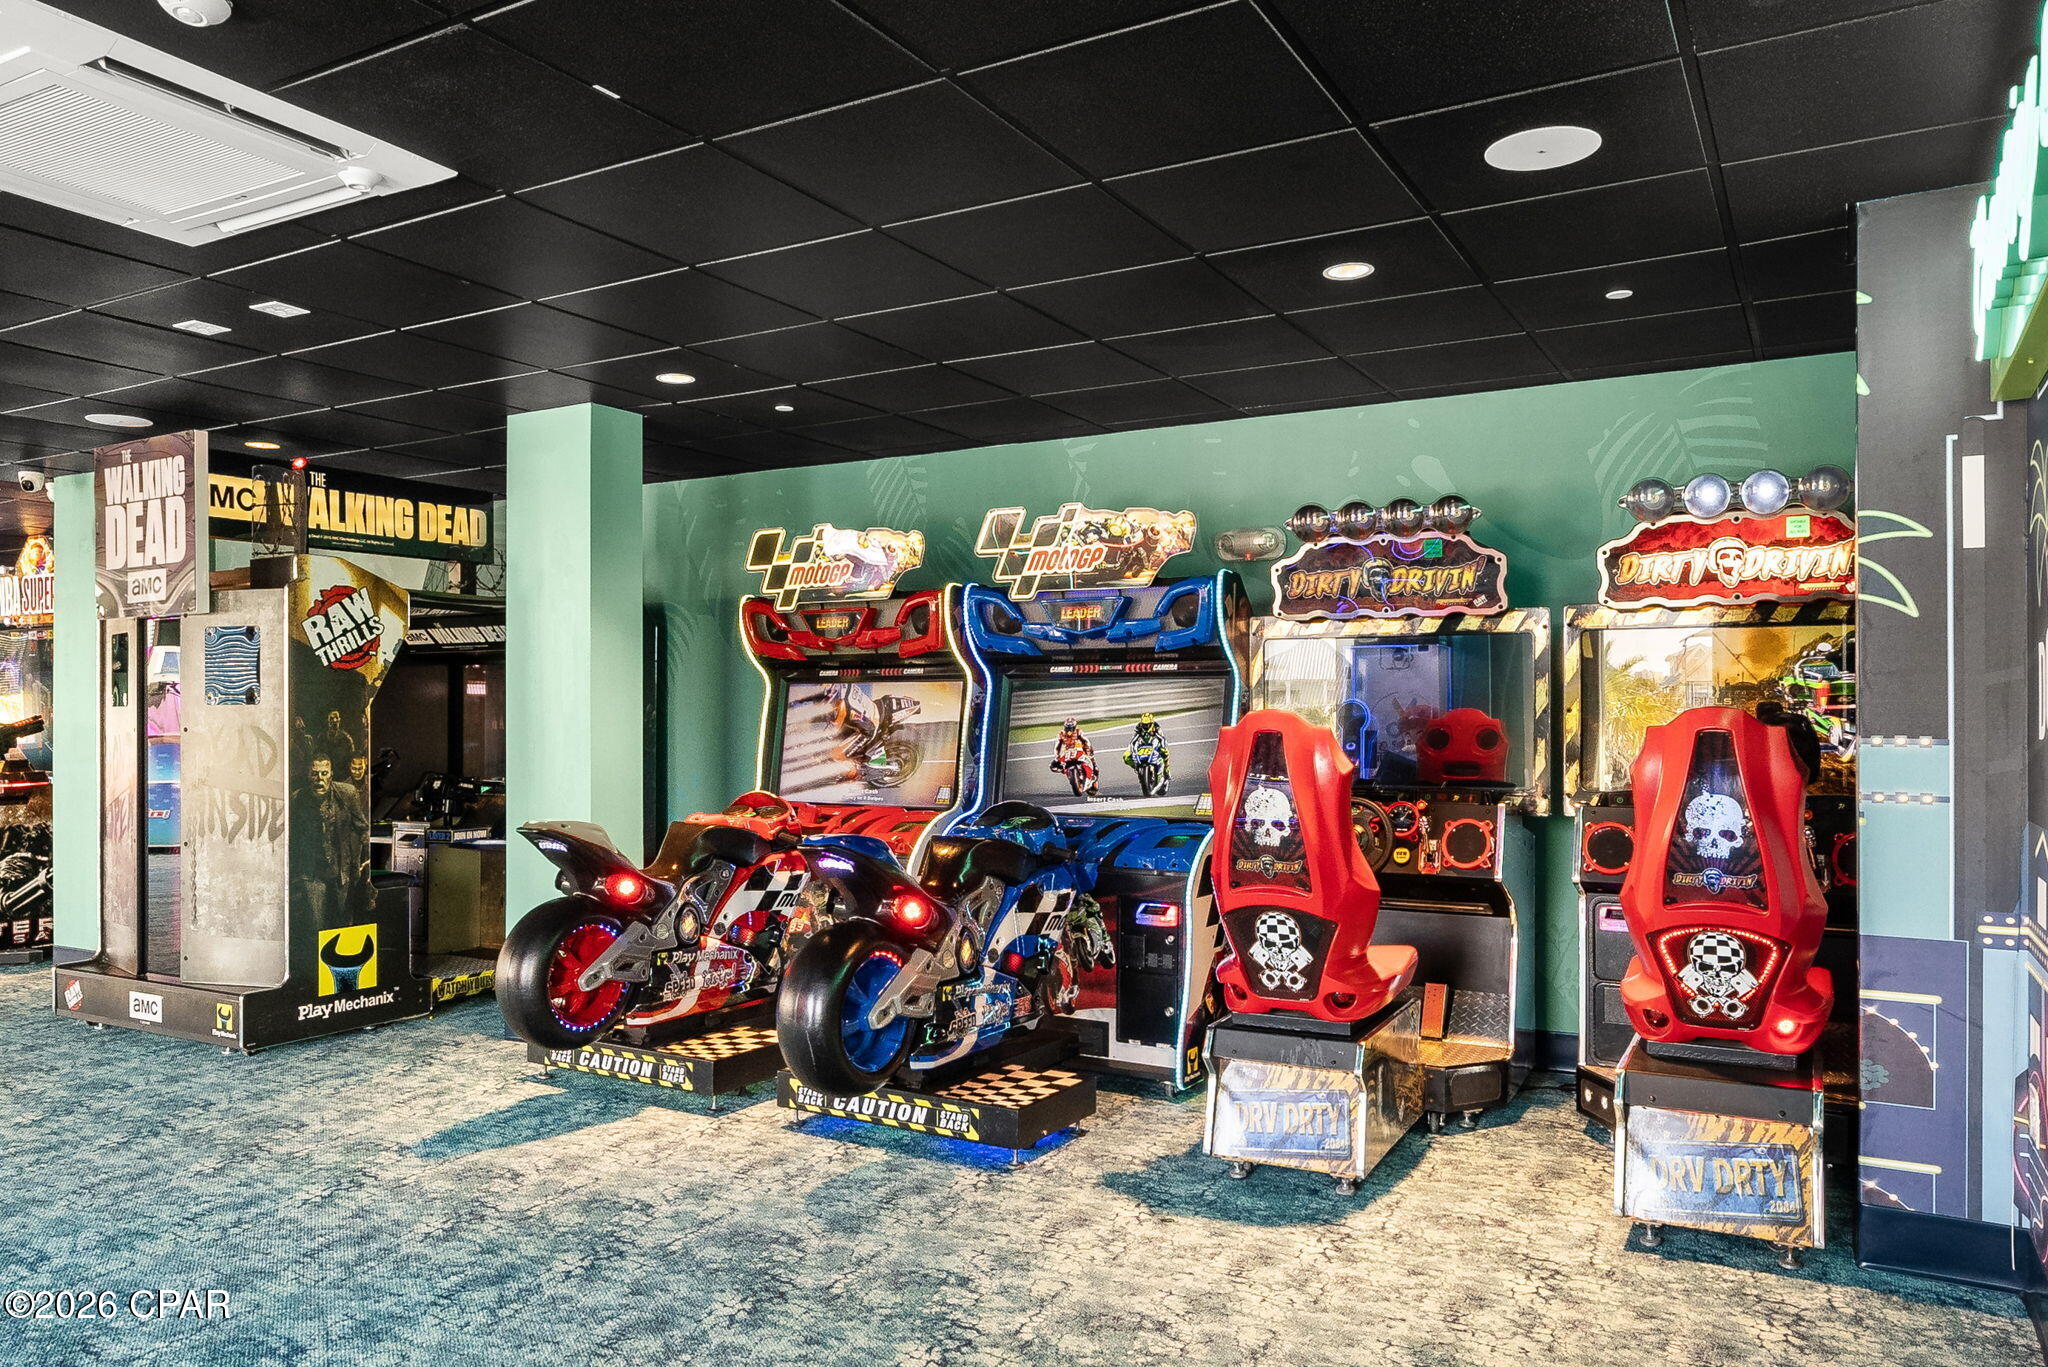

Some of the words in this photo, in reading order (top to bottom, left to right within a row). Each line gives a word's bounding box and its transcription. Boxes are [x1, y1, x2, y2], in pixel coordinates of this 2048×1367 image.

[121, 450, 132, 463] THE
[104, 455, 186, 505] WALKING
[310, 471, 326, 488] THE
[210, 483, 257, 512] MC
[419, 501, 487, 547] DEAD
[105, 496, 186, 571] DEAD
[1027, 546, 1104, 572] motoGP
[1617, 549, 1708, 586] DIRTY
[788, 562, 851, 586] motoGP
[1289, 568, 1361, 600] DIRTY
[302, 587, 374, 650] RAW
[816, 616, 849, 629] LEADER
[1060, 606, 1101, 620] LEADER
[314, 616, 385, 667] THRILLS
[1152, 663, 1178, 671] CAMERA
[1674, 874, 1703, 885] DIRTY
[672, 951, 696, 965] Play
[696, 950, 738, 961] Mechanix
[298, 1002, 334, 1021] Play
[334, 991, 394, 1014] Mechanix
[550, 1051, 572, 1063] BACK
[579, 1052, 653, 1077] CAUTION
[662, 1064, 685, 1075] STAND
[662, 1073, 686, 1083] BACK
[798, 1095, 823, 1107] BACK
[833, 1097, 928, 1124] CAUTION
[939, 1120, 969, 1132] BACK
[940, 1112, 968, 1123] STAND
[1235, 1102, 1278, 1134] DRV
[1284, 1102, 1341, 1136] DRTY
[1651, 1156, 1705, 1193] DRV
[1713, 1157, 1786, 1197] DRTY
[1769, 1201, 1797, 1213] 2084
